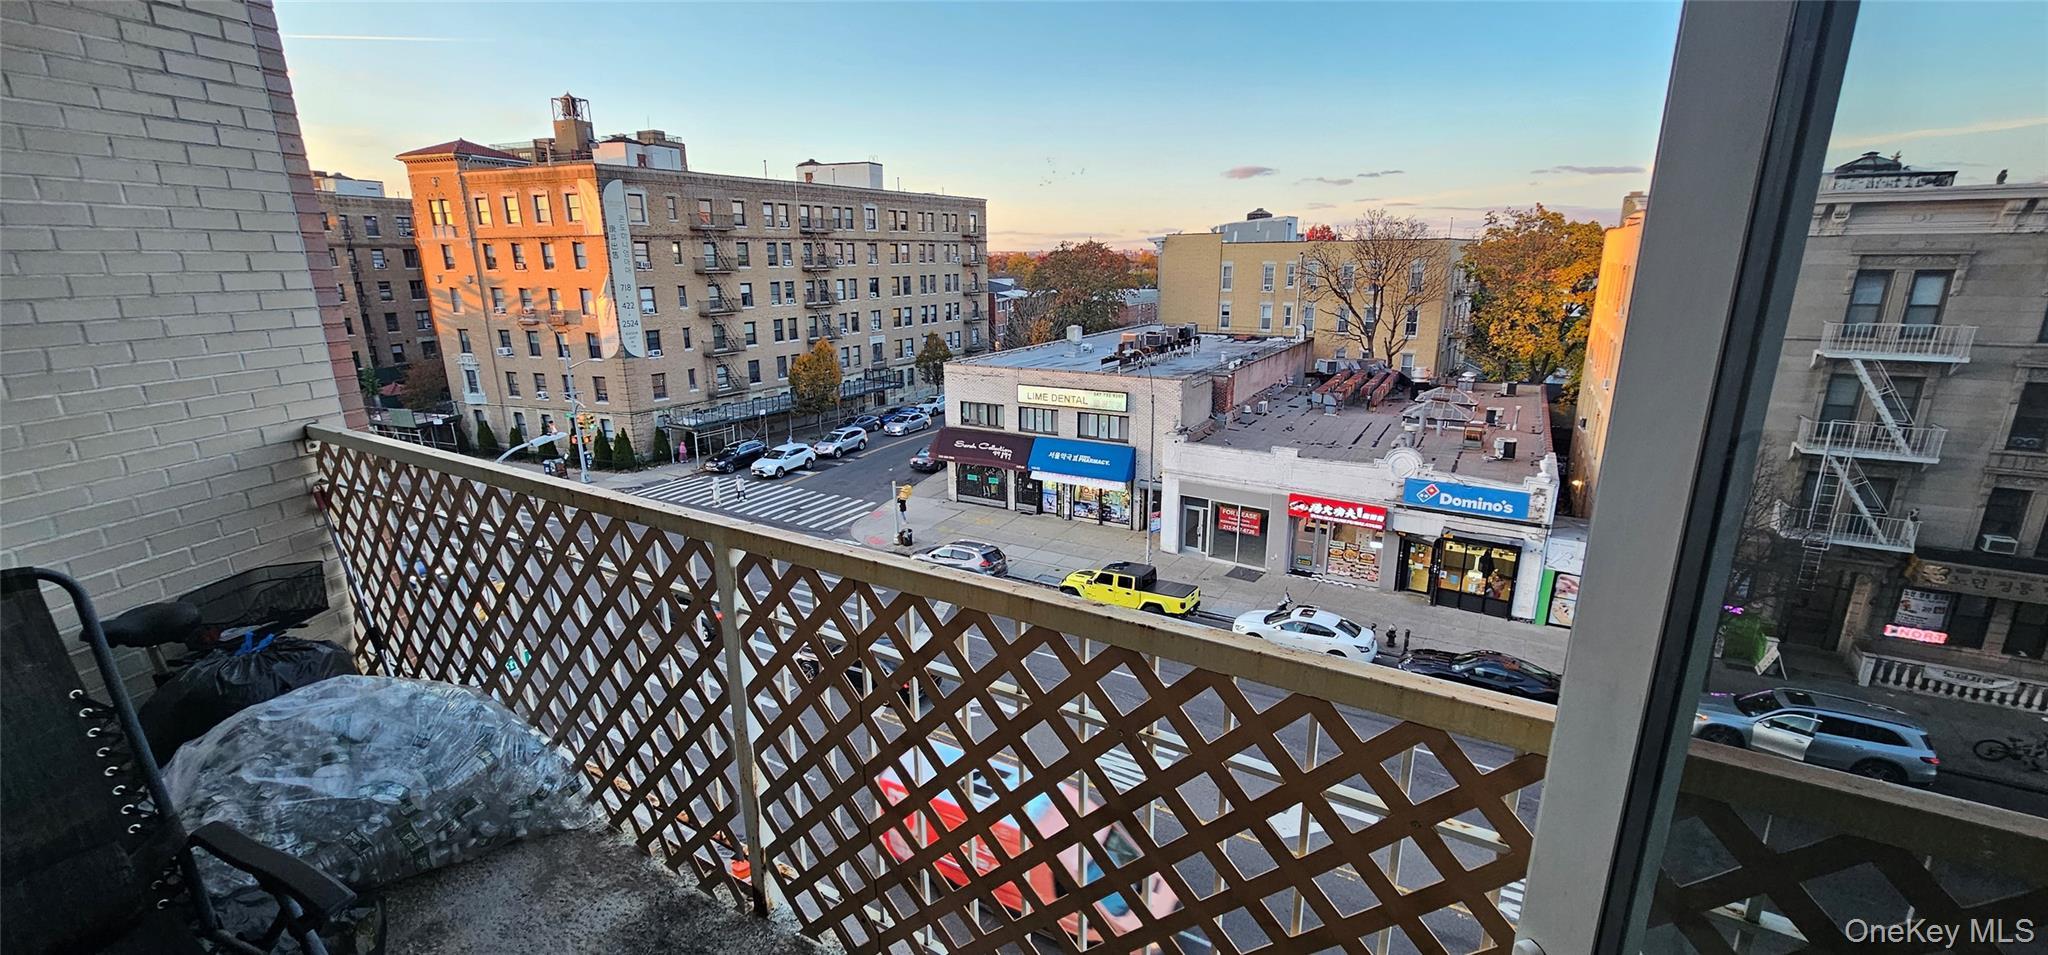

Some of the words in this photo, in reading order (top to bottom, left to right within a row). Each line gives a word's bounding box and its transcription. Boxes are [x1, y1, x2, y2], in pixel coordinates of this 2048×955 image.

[620, 284, 632, 292] 718
[621, 302, 635, 310] 422
[622, 320, 639, 328] 2524
[1027, 392, 1049, 402] LIME
[1051, 393, 1089, 405] DENTAL
[978, 442, 1013, 454] Collection
[1439, 492, 1514, 514] Domino's
[1222, 508, 1236, 516] FOR
